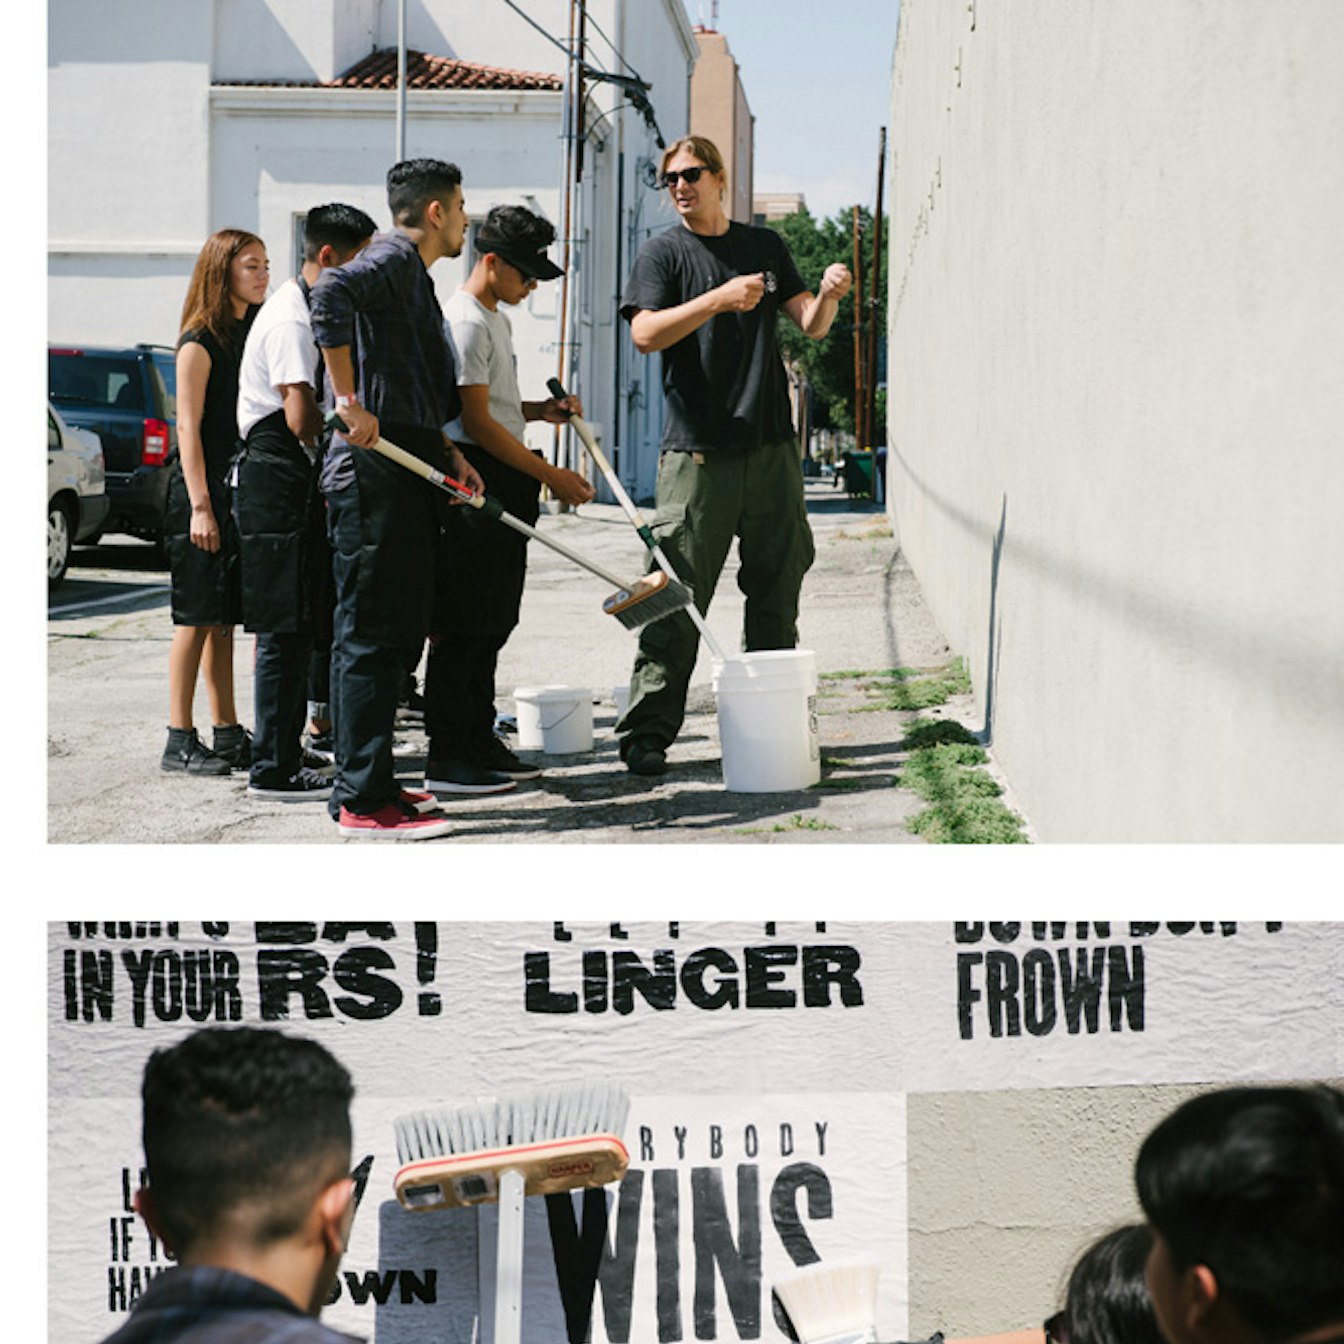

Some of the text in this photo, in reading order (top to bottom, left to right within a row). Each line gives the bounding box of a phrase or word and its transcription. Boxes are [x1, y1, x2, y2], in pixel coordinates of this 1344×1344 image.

[64, 949, 114, 1021] IN
[121, 948, 242, 1027] YOUR
[524, 945, 864, 1015] LINGER
[956, 945, 1145, 1040] FROWN
[640, 1122, 828, 1162] RYBODY
